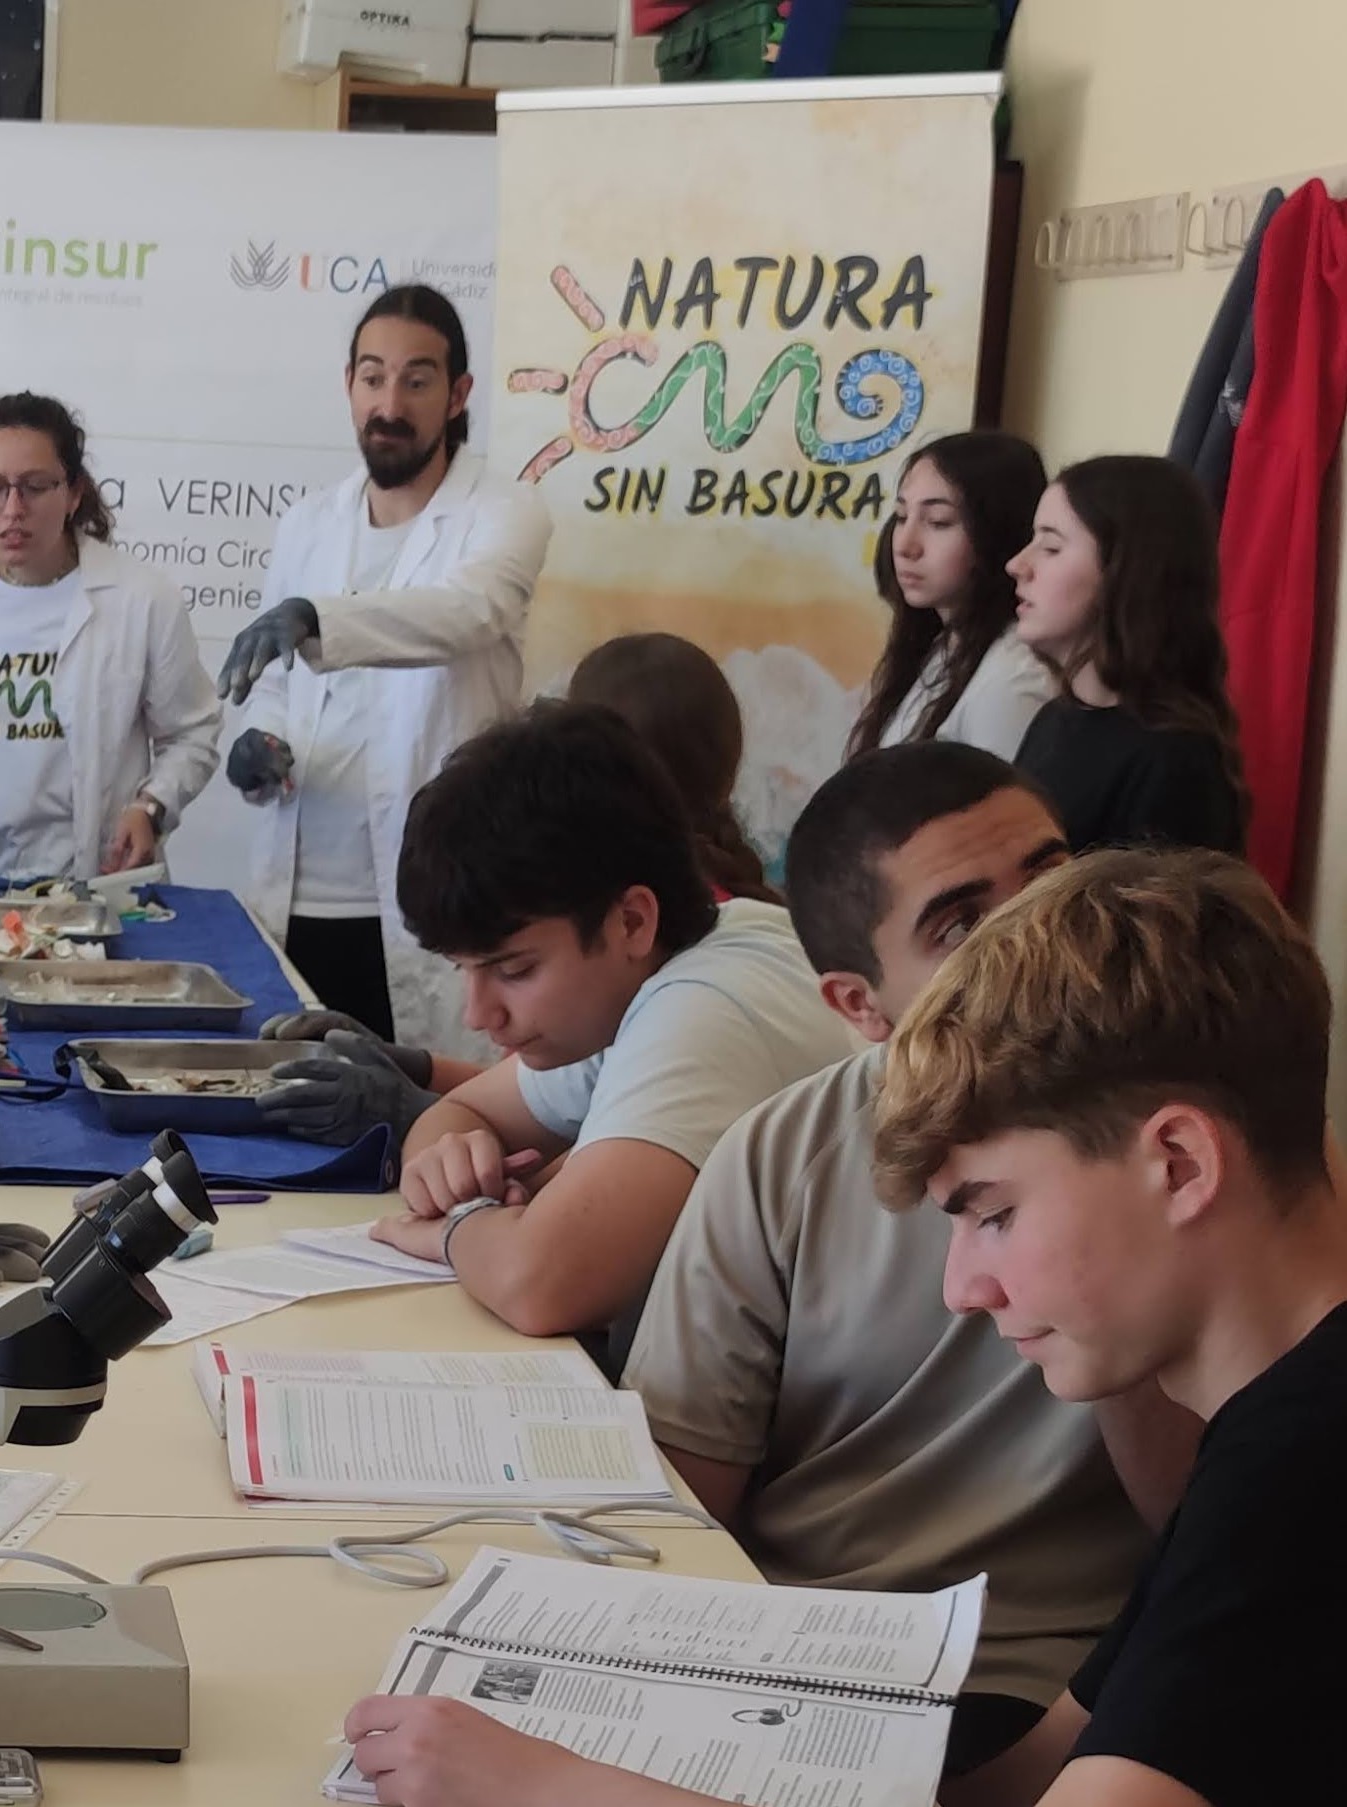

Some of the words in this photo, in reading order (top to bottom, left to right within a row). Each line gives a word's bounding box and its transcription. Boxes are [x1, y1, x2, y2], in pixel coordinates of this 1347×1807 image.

[360, 10, 410, 26] OPTIKA
[300, 256, 389, 293] UCA
[620, 254, 933, 332] NATURA
[158, 477, 307, 519] VERINS
[584, 466, 666, 513] SIN
[685, 468, 886, 521] BASURA
[182, 582, 262, 611] genie
